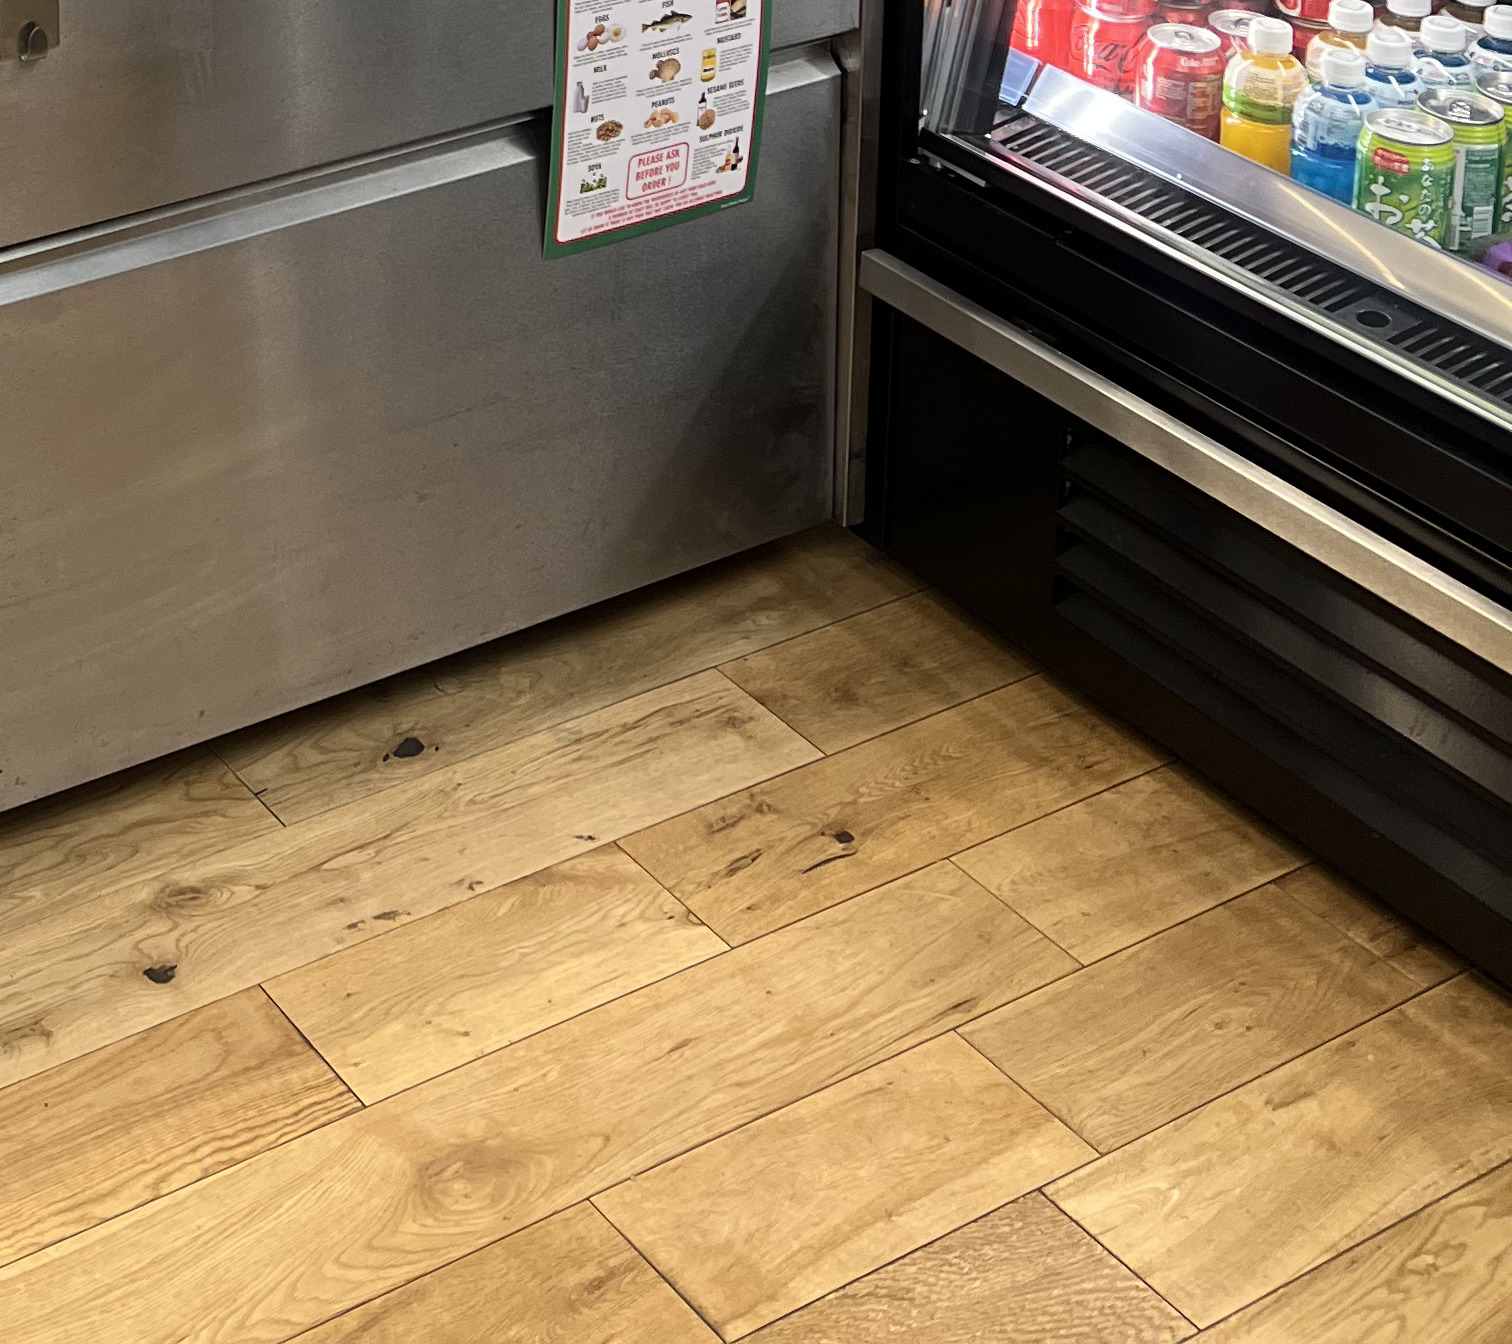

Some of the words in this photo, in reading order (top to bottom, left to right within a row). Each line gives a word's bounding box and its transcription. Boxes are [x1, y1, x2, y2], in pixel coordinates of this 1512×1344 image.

[638, 153, 664, 168] PLEASE
[666, 149, 680, 160] ASK
[635, 165, 664, 181] BEFORE
[665, 161, 680, 173] YOU
[641, 177, 667, 192] ORDER
